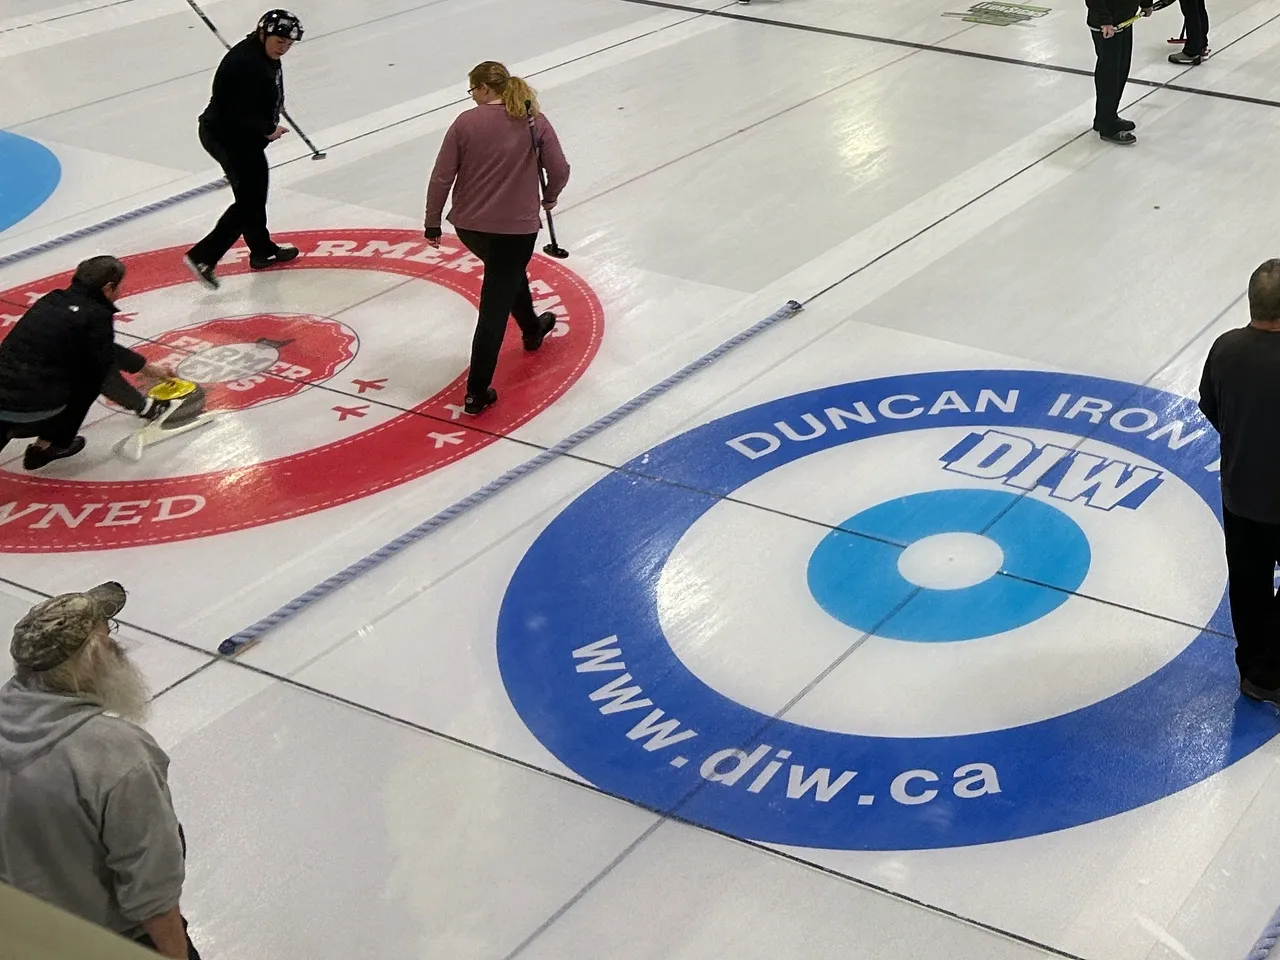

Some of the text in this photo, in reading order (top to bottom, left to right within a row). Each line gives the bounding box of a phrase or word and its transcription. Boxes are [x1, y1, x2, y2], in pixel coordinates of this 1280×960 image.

[218, 240, 485, 274] FRMER
[725, 388, 1207, 461] DUNCAN IRON
[944, 429, 1166, 512] DIW
[572, 634, 1002, 807] www.diw.ca
